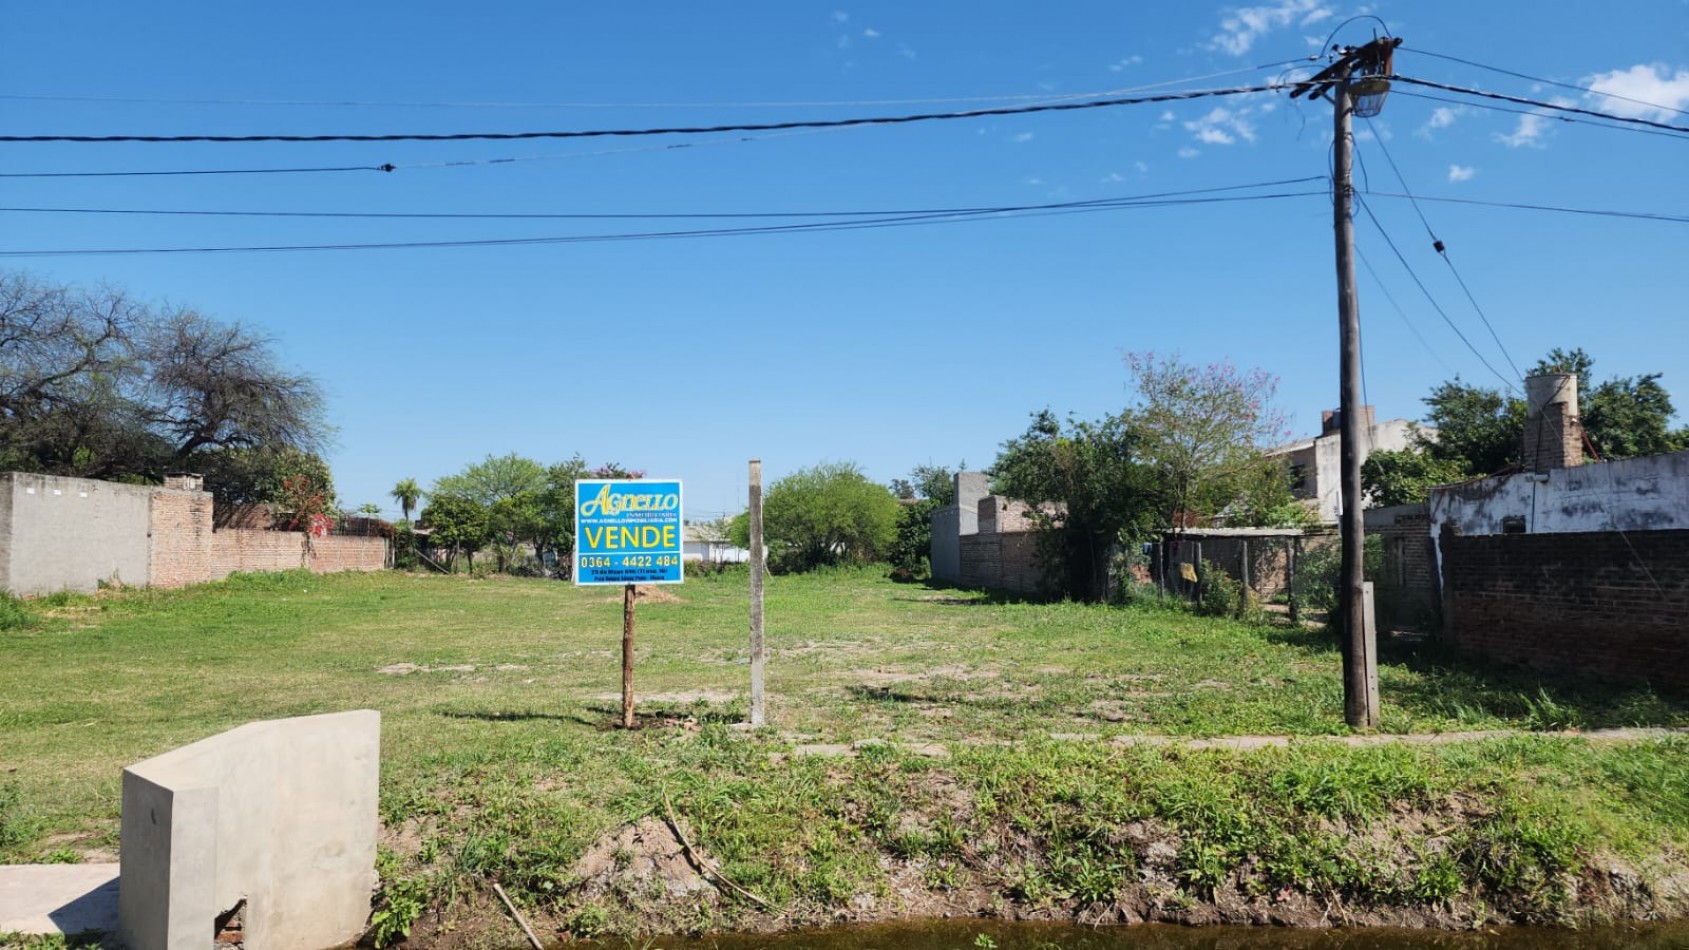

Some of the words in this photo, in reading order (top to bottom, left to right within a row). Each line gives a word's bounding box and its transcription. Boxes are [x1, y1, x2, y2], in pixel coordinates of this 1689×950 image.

[584, 525, 675, 549] VENDE
[581, 557, 610, 567] 0364
[622, 556, 652, 567] 4422
[656, 555, 678, 566] 484
